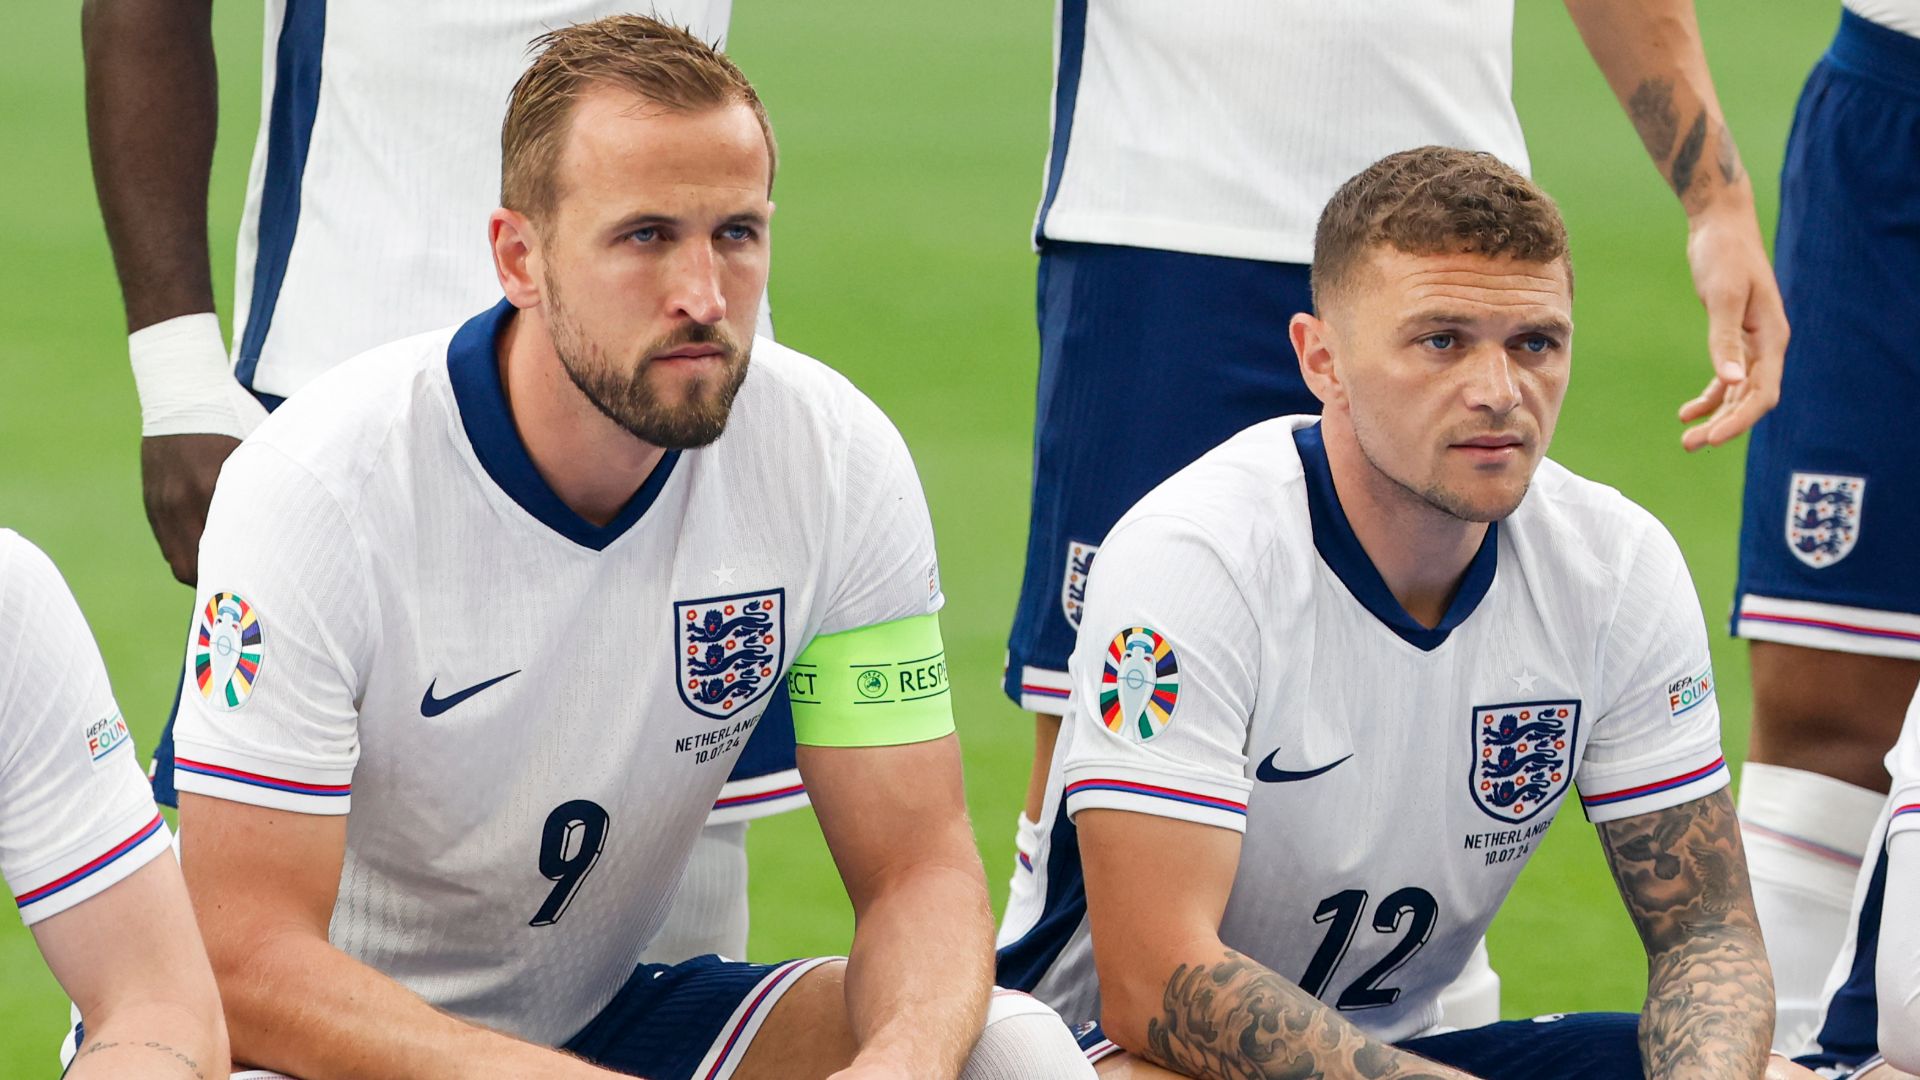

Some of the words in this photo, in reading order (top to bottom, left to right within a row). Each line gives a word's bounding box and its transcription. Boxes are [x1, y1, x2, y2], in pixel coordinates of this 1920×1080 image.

[1669, 676, 1693, 694] UEFA
[86, 718, 108, 738] UEFA
[695, 737, 740, 765] 10.07.24
[528, 799, 610, 927] 9
[1485, 843, 1529, 867] 10.07.24
[1298, 886, 1439, 1011] 12
